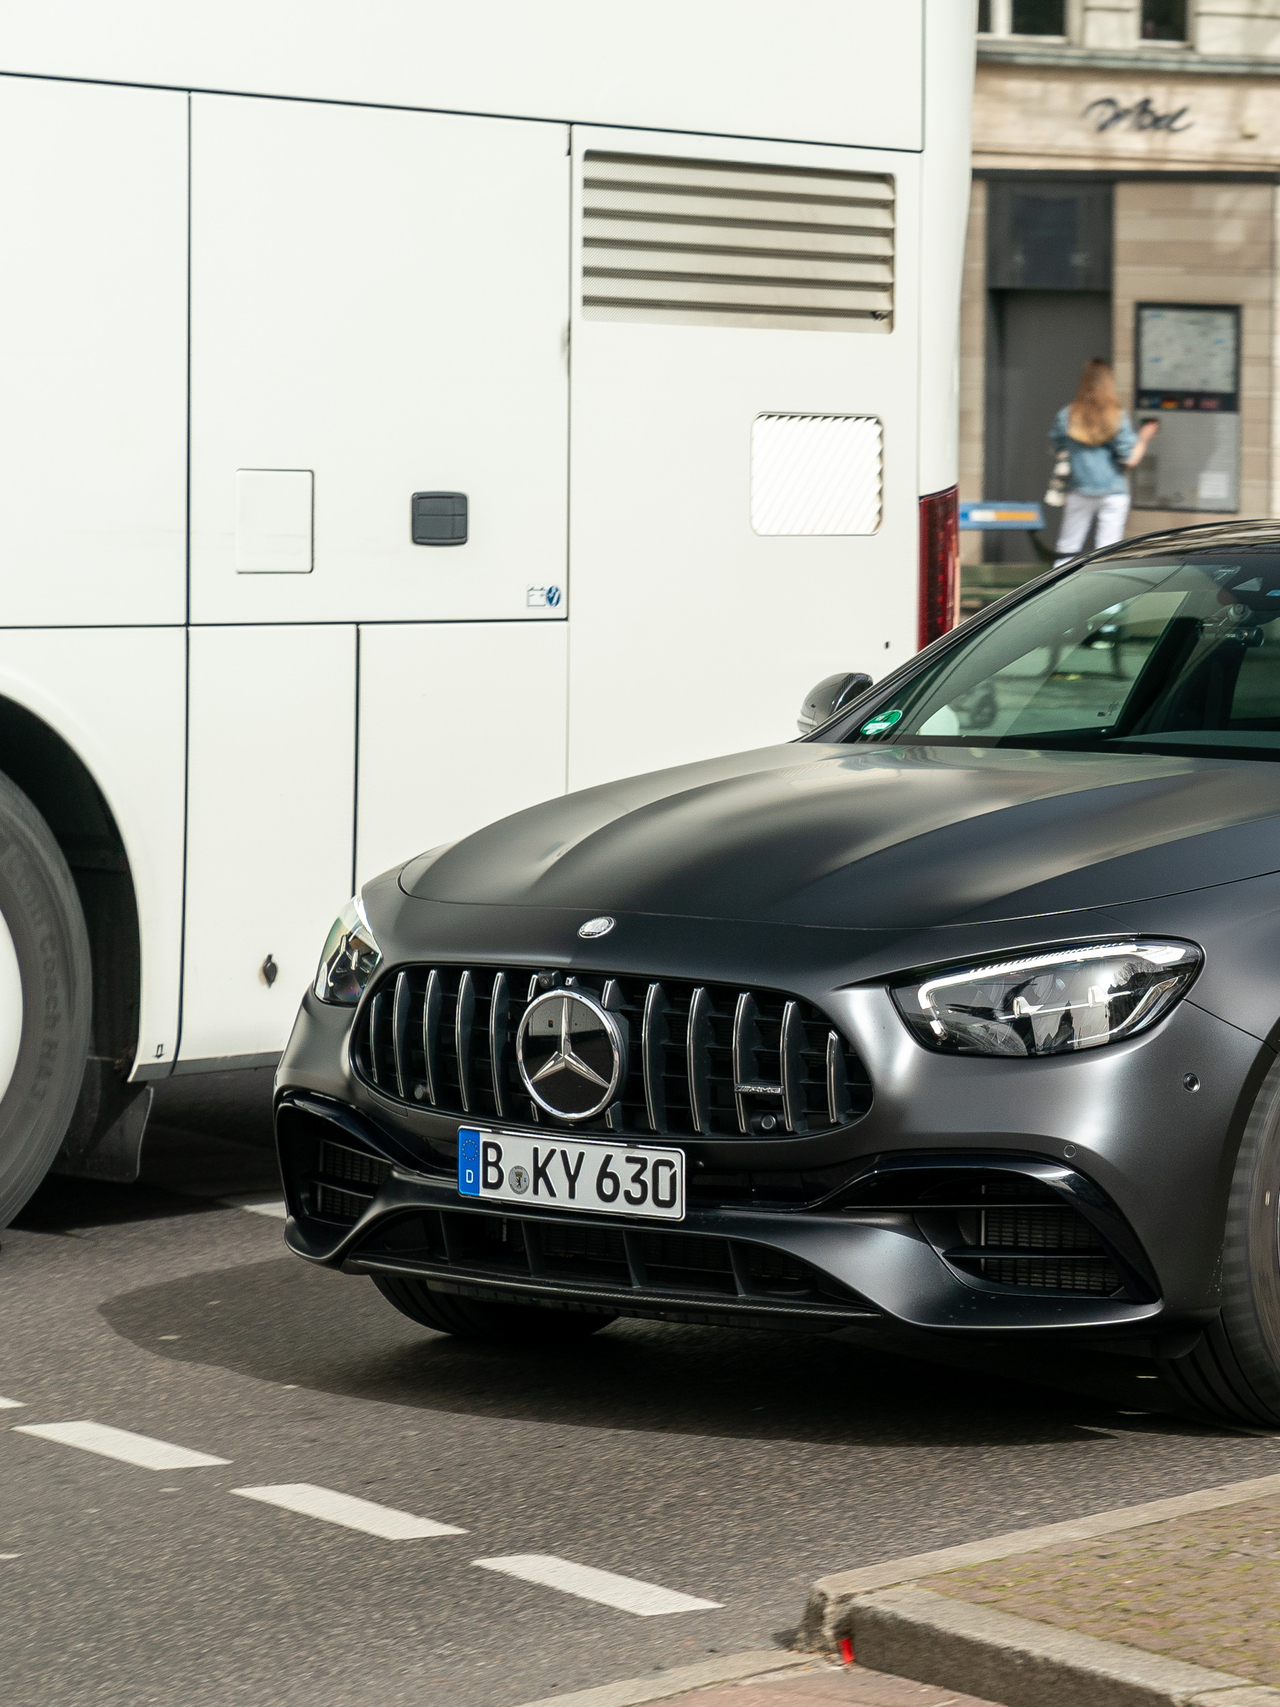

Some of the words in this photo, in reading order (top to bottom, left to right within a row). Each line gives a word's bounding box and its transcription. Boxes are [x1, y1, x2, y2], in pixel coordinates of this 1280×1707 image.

[465, 1169, 474, 1184] D
[482, 1140, 504, 1190] B
[532, 1146, 586, 1200] KY
[596, 1154, 678, 1209] 630
